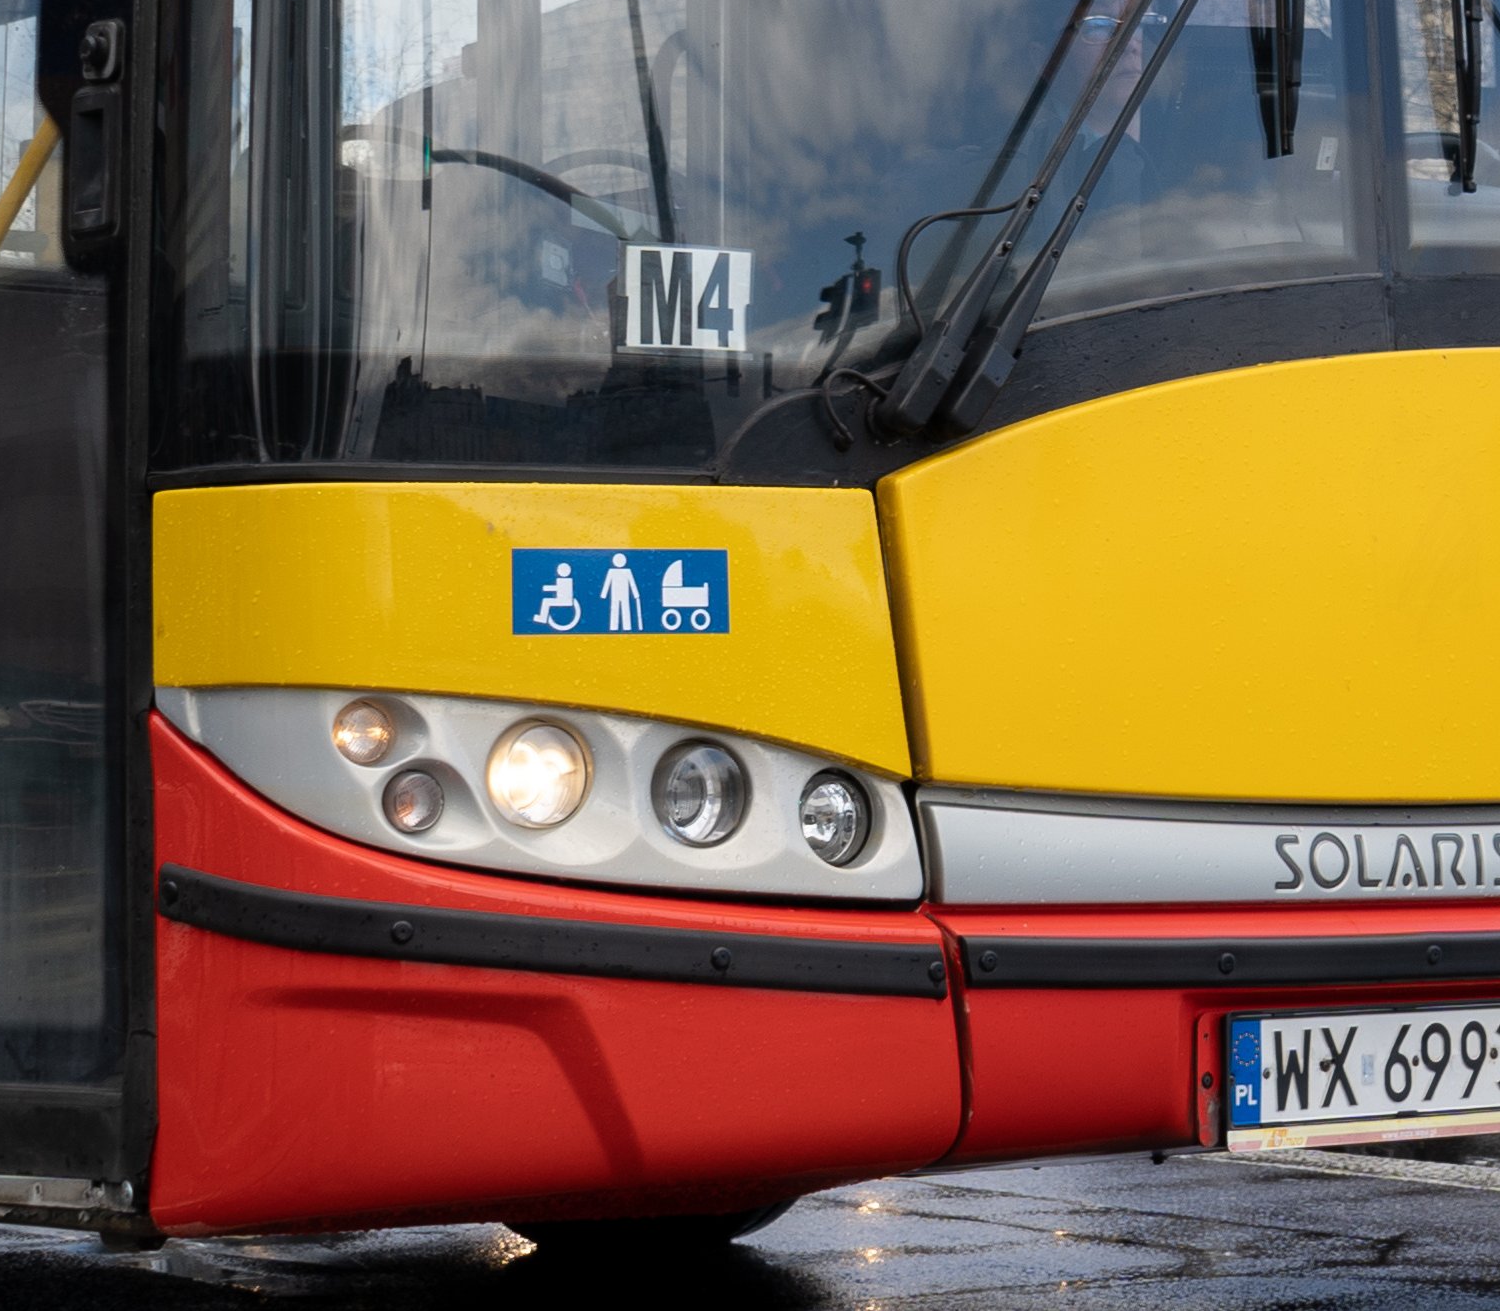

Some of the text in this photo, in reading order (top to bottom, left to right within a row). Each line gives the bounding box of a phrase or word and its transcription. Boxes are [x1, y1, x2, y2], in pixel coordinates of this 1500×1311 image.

[640, 250, 734, 348] M4
[1234, 1083, 1258, 1107] PL
[1274, 1026, 1358, 1112] WX
